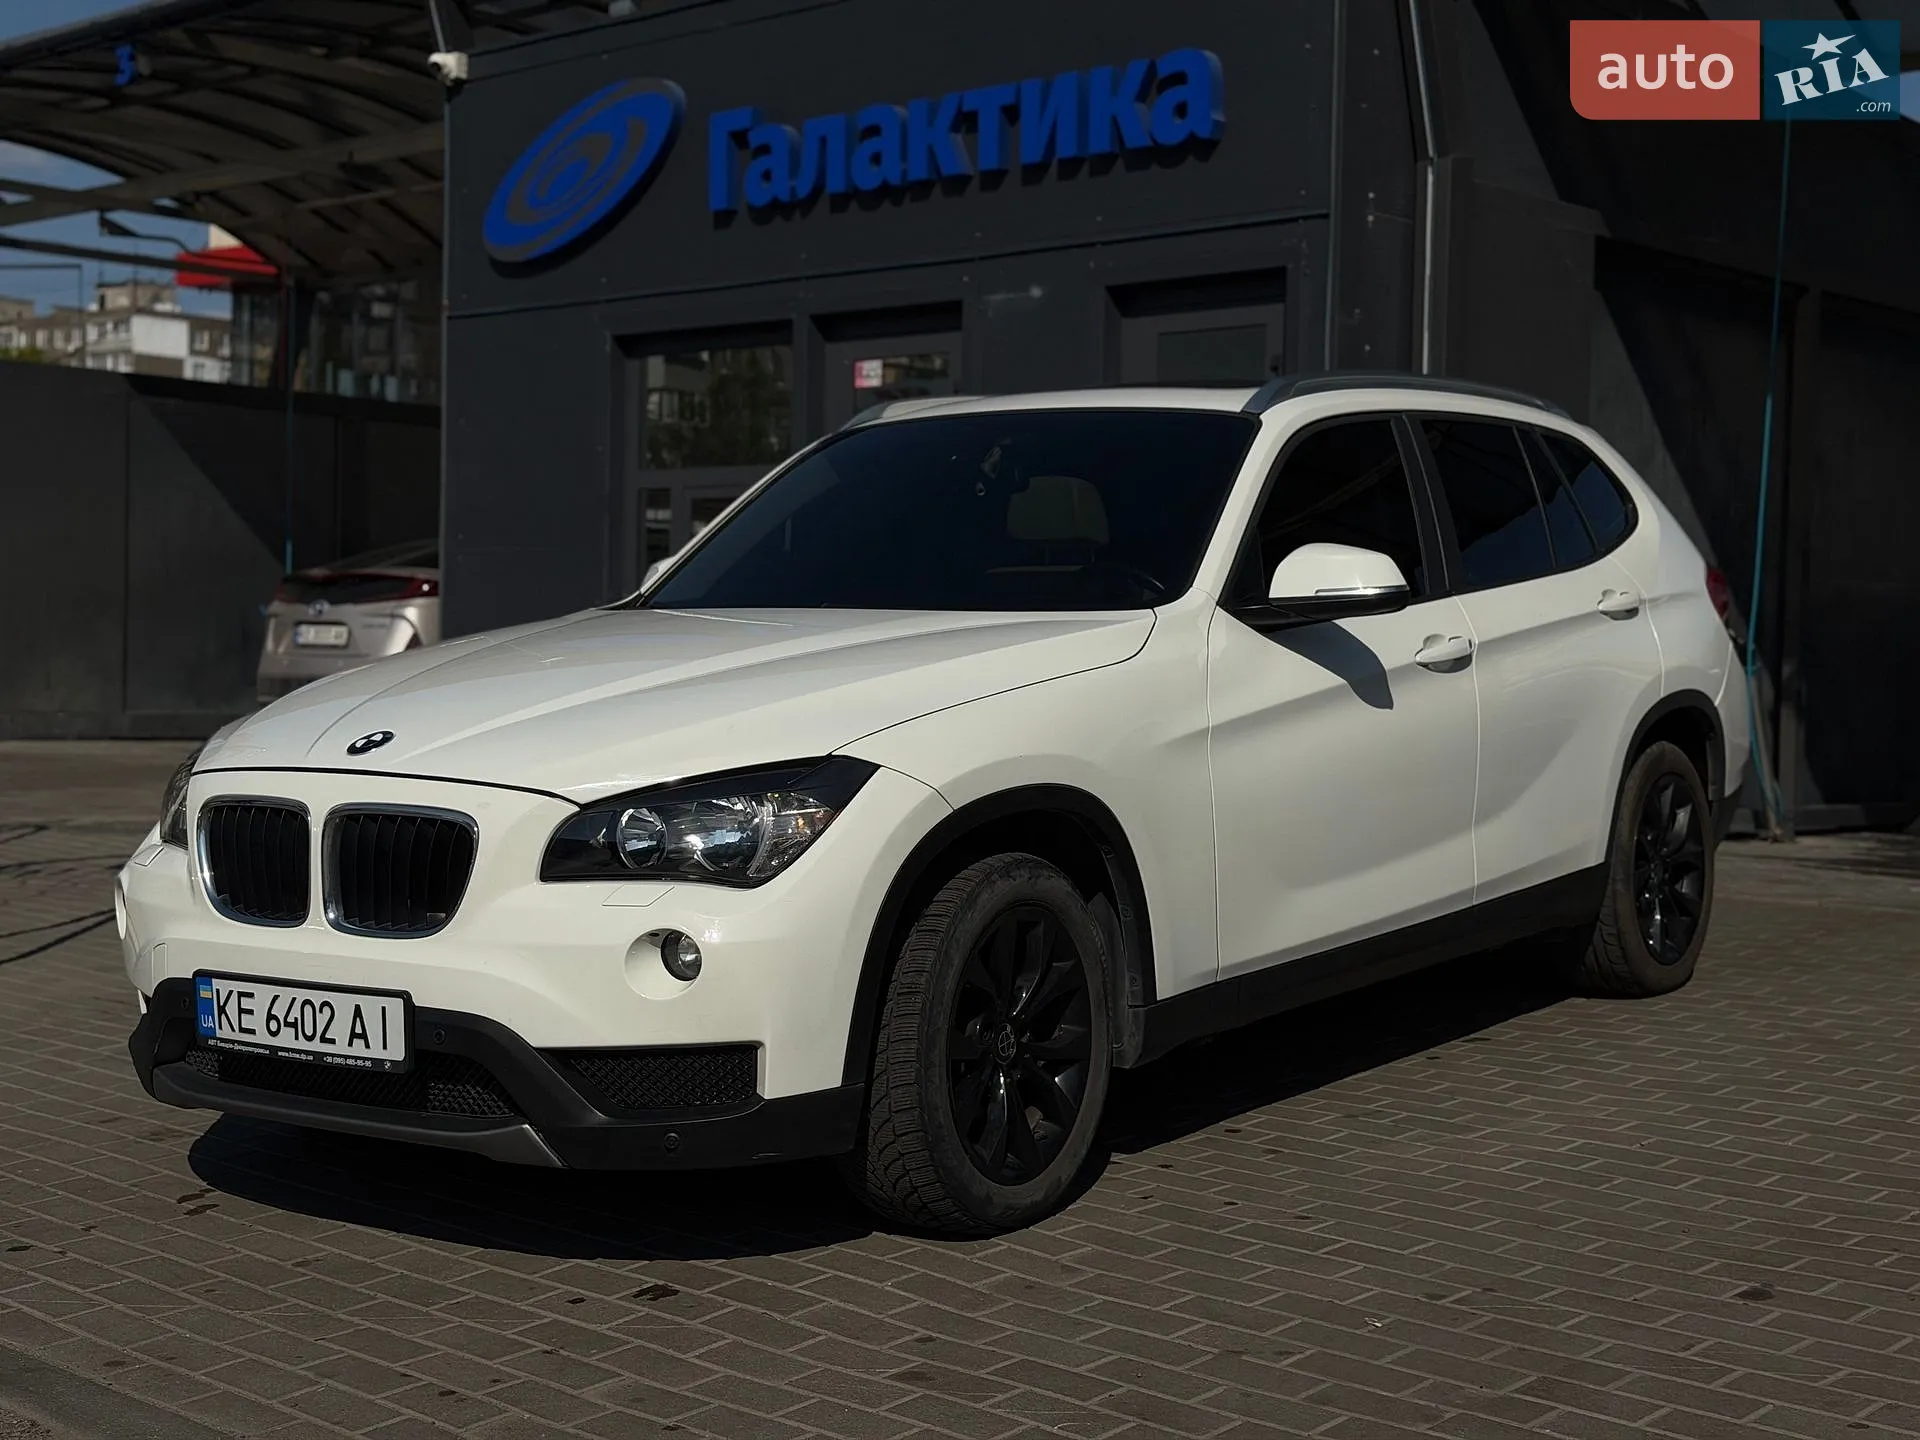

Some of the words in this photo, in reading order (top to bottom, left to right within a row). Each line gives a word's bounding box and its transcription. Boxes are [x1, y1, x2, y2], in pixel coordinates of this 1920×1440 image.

[707, 46, 1225, 212] Галактика
[201, 1014, 215, 1029] UA
[215, 987, 257, 1037] KE
[265, 994, 337, 1046] 6402
[347, 1003, 388, 1051] AI
